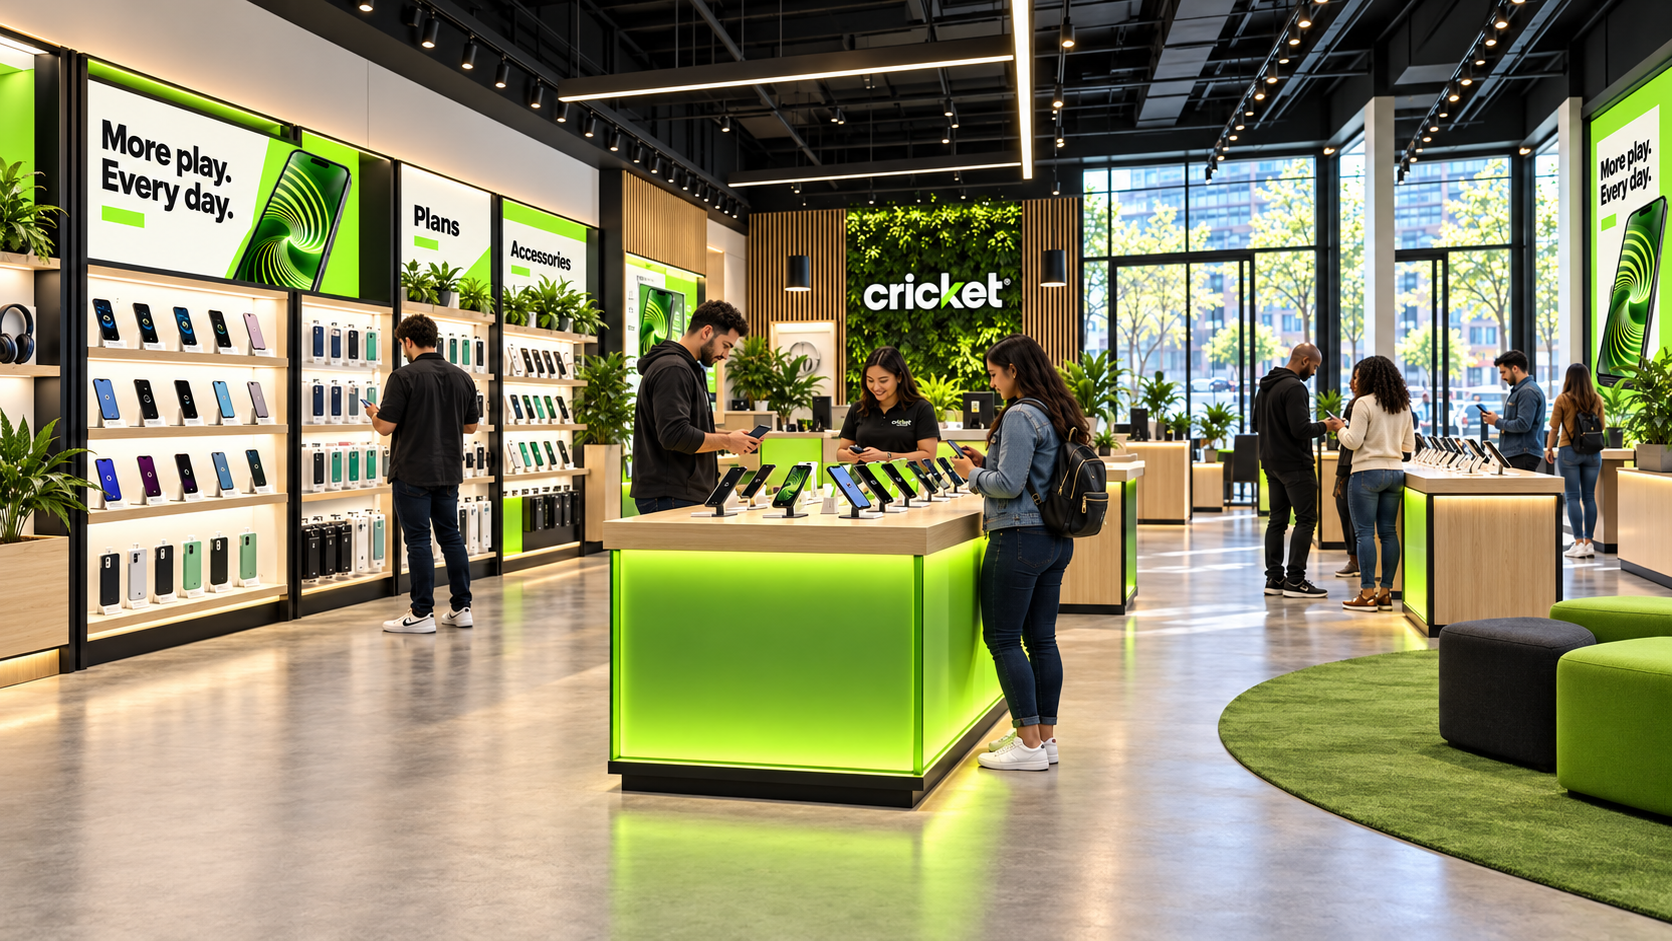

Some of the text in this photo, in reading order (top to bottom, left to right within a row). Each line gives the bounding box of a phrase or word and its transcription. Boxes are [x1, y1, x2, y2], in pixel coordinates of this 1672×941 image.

[102, 119, 232, 187] More play.
[1600, 139, 1652, 181] More play.
[102, 157, 234, 224] Every day.
[1600, 166, 1652, 206] Every day.
[414, 204, 460, 237] Plans
[510, 240, 571, 271] Accessories
